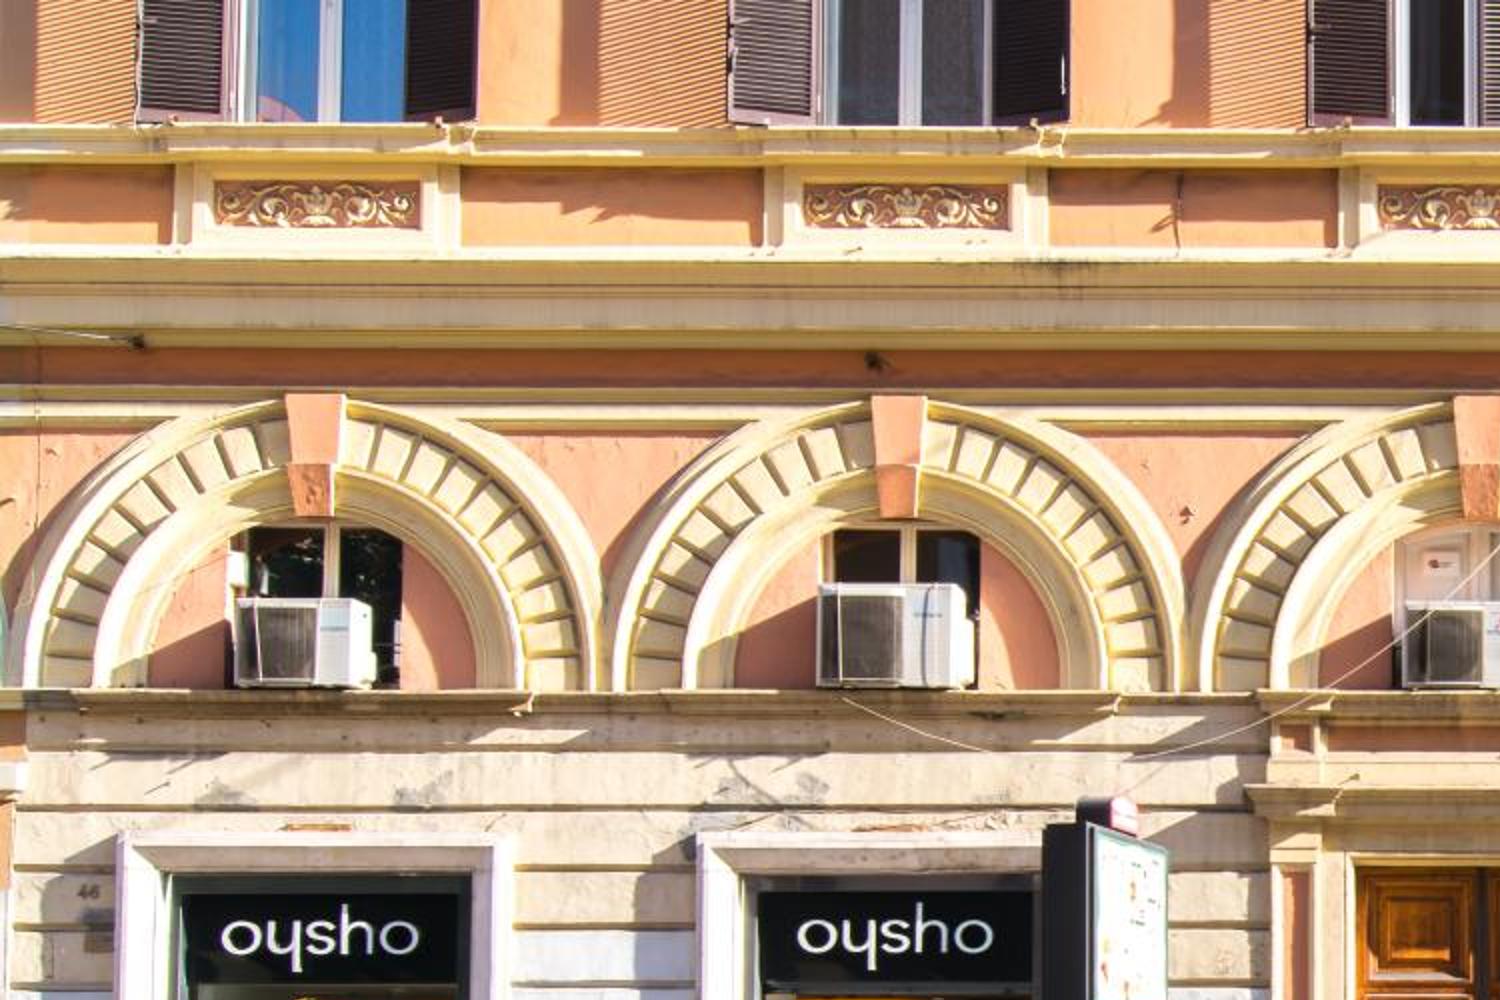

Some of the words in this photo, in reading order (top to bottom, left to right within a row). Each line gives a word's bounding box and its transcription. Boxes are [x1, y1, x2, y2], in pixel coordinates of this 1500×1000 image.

[76, 883, 101, 900] 46
[220, 903, 420, 974] oysho
[796, 901, 994, 972] oysho
